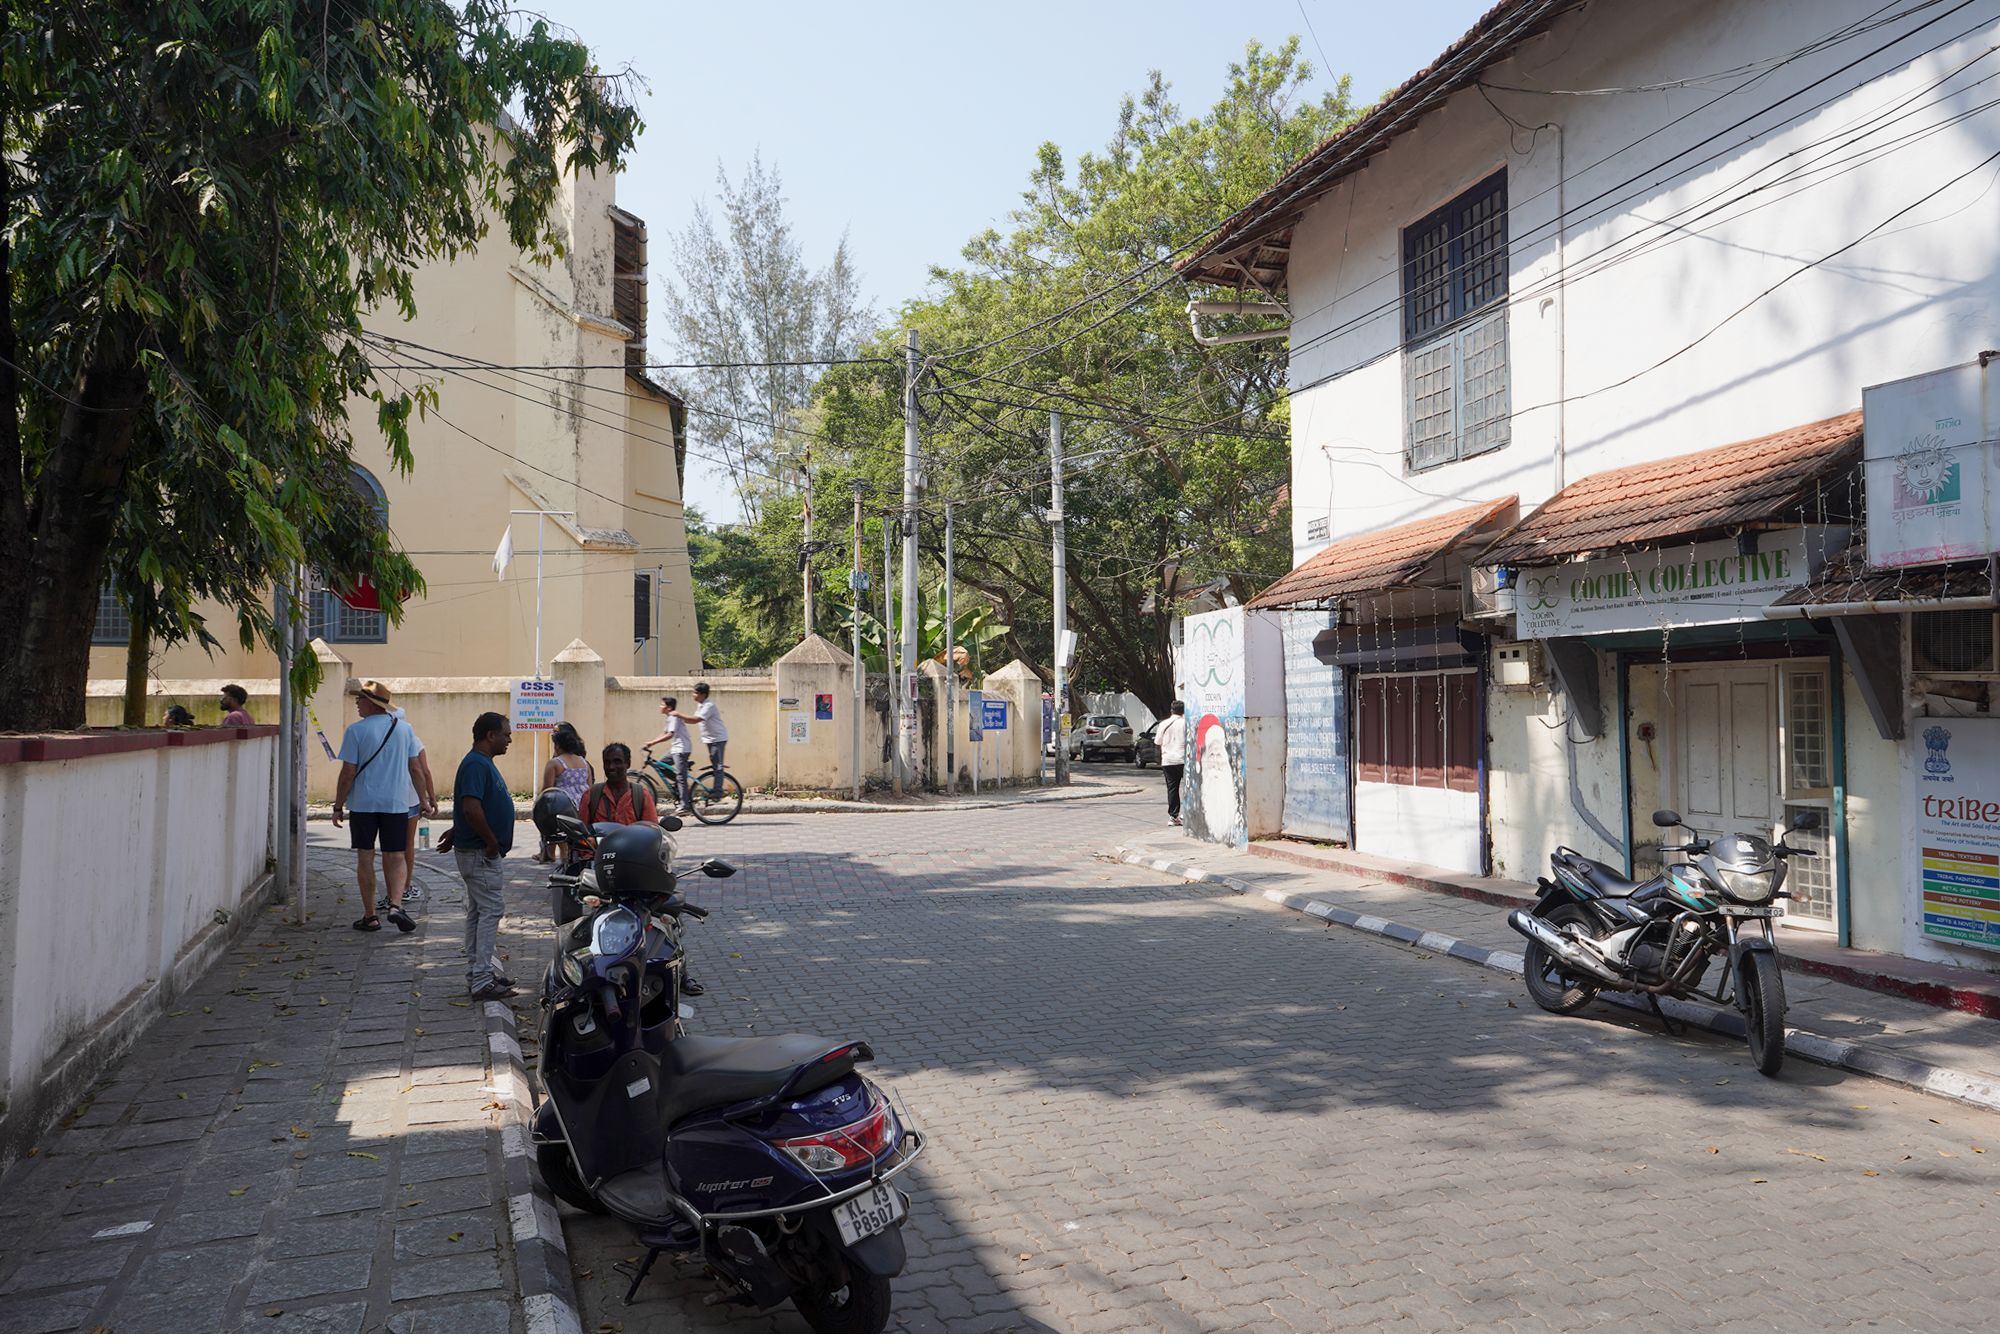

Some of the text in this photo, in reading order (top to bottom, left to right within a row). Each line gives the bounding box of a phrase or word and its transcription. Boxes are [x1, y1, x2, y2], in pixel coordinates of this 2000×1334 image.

[1571, 548, 1791, 603] COCHIN COLLECTIVE
[1526, 618, 1560, 629] COLLECTIVE
[521, 681, 554, 691] CSS
[602, 852, 616, 860] TVS
[1955, 875, 1985, 884] PAINTINGS
[1959, 897, 1981, 906] POTTERY
[832, 1093, 851, 1106] TVS
[696, 1180, 750, 1193] Jupiter
[846, 1185, 889, 1220] KL 43
[853, 1202, 894, 1238] P8507
